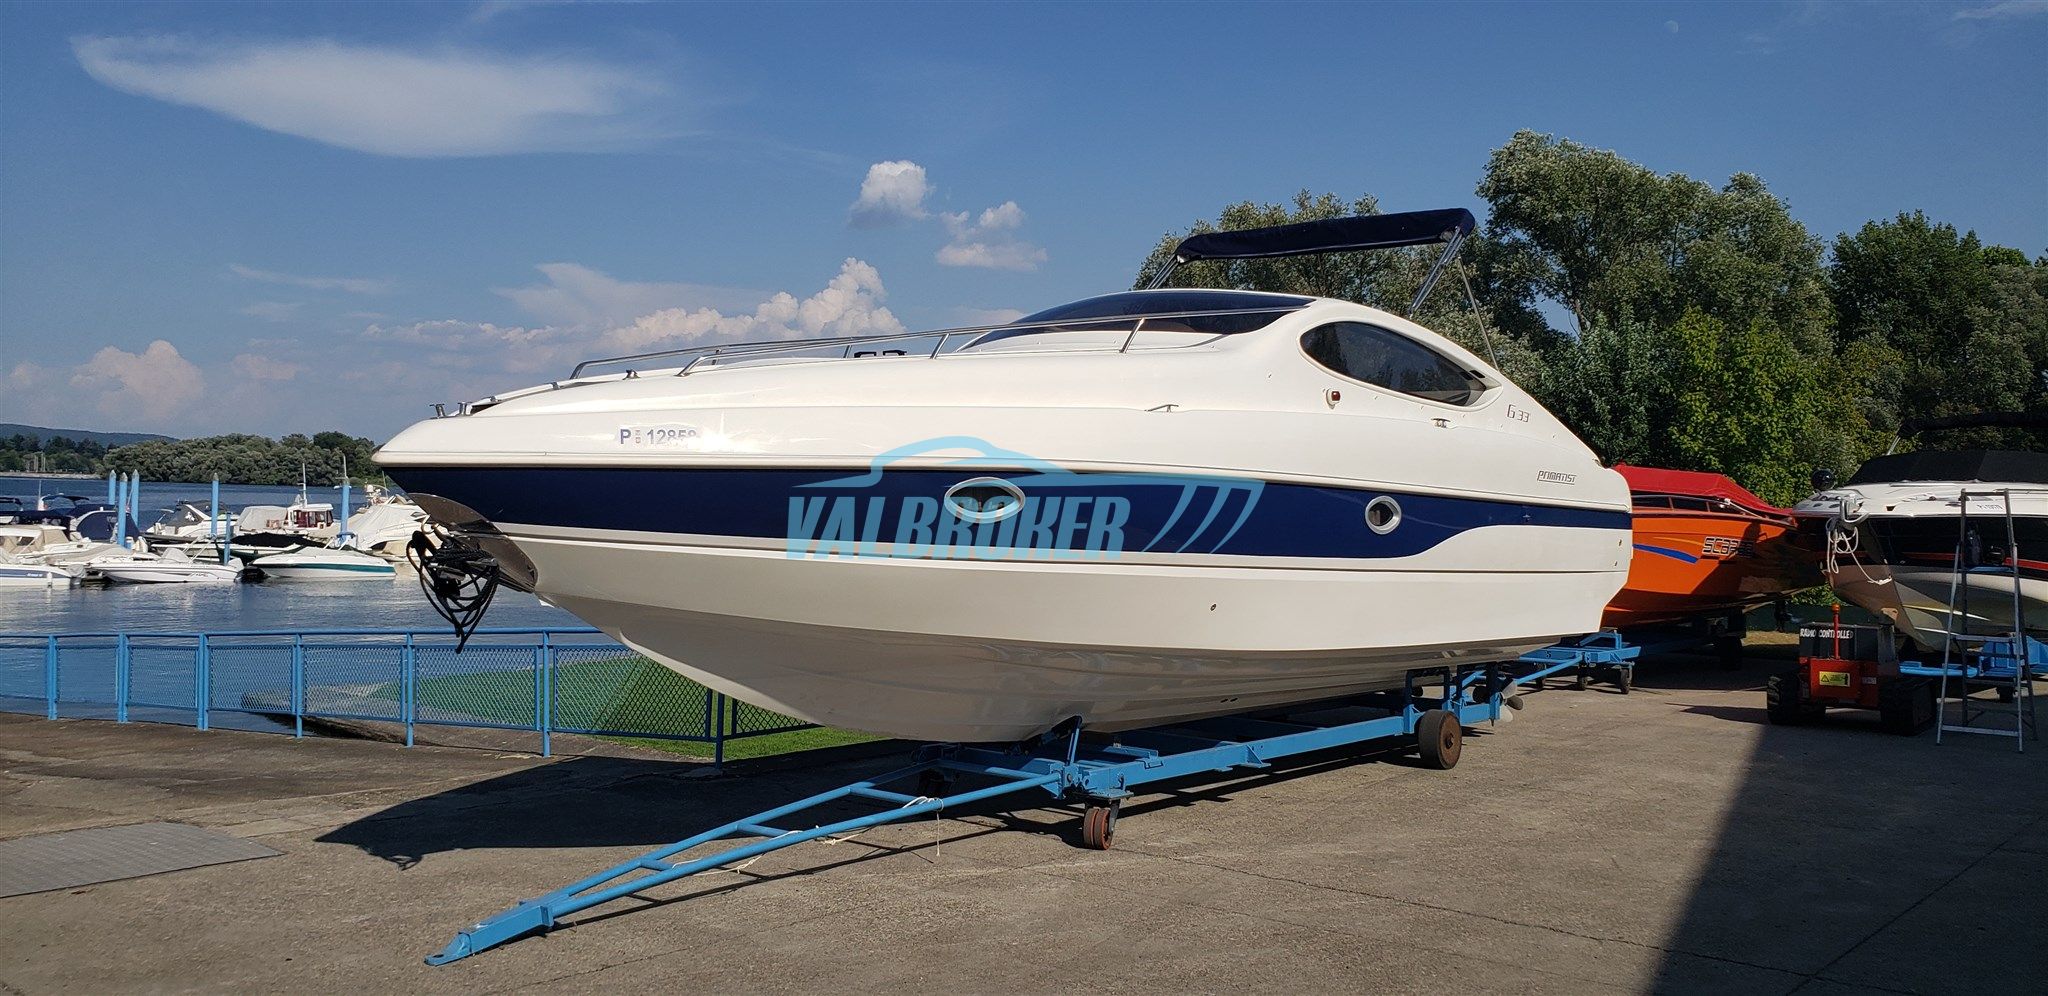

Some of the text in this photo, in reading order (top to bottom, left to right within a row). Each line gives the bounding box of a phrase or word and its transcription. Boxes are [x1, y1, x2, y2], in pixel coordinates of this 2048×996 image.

[1507, 404, 1531, 423] G 33
[620, 429, 632, 444] P
[1537, 470, 1577, 485] PRIMATIST
[1800, 628, 1854, 639] RADIO CONTOLLED
